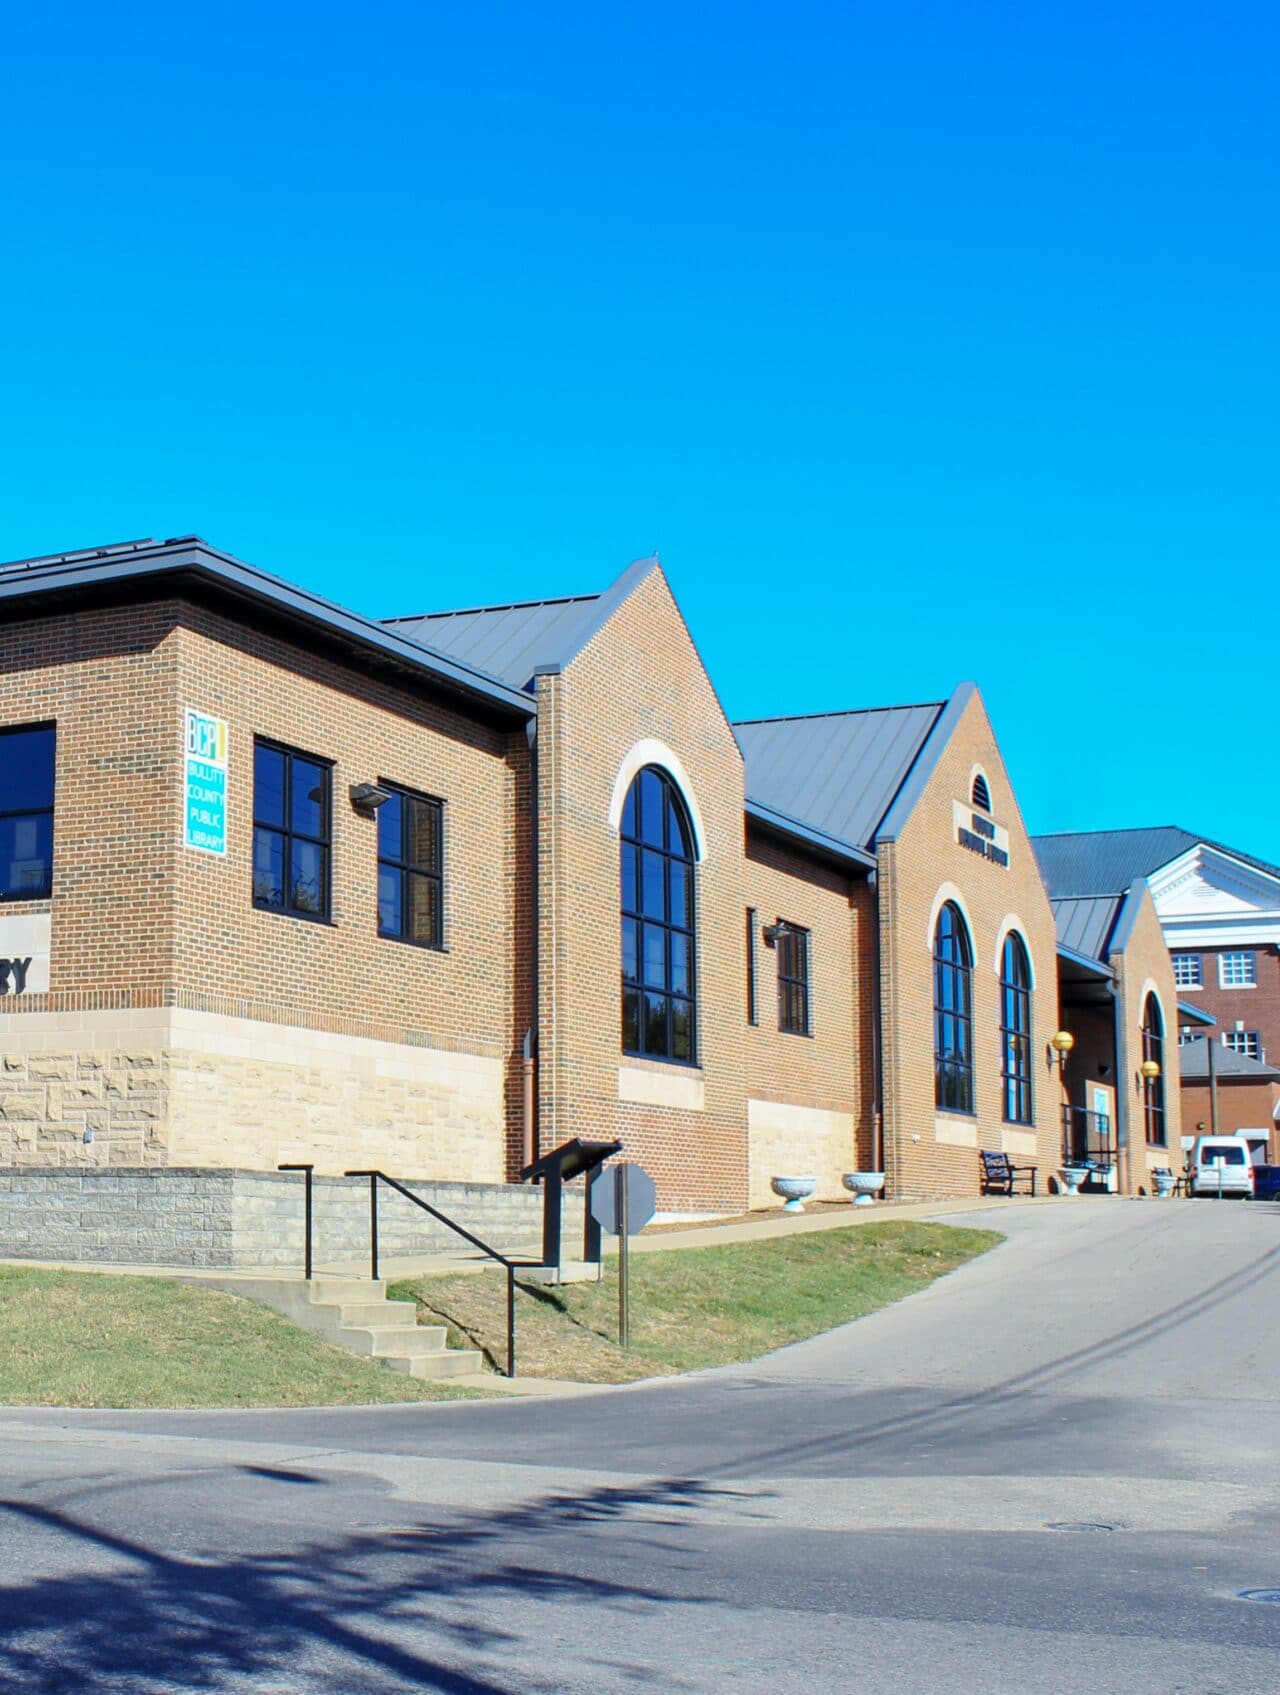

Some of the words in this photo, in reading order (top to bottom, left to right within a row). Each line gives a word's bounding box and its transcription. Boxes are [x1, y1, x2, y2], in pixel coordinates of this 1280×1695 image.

[188, 764, 224, 784] BULLITT
[187, 785, 224, 805] COUNTY
[190, 808, 221, 828] PUBLIC
[187, 829, 224, 850] LIBRARY
